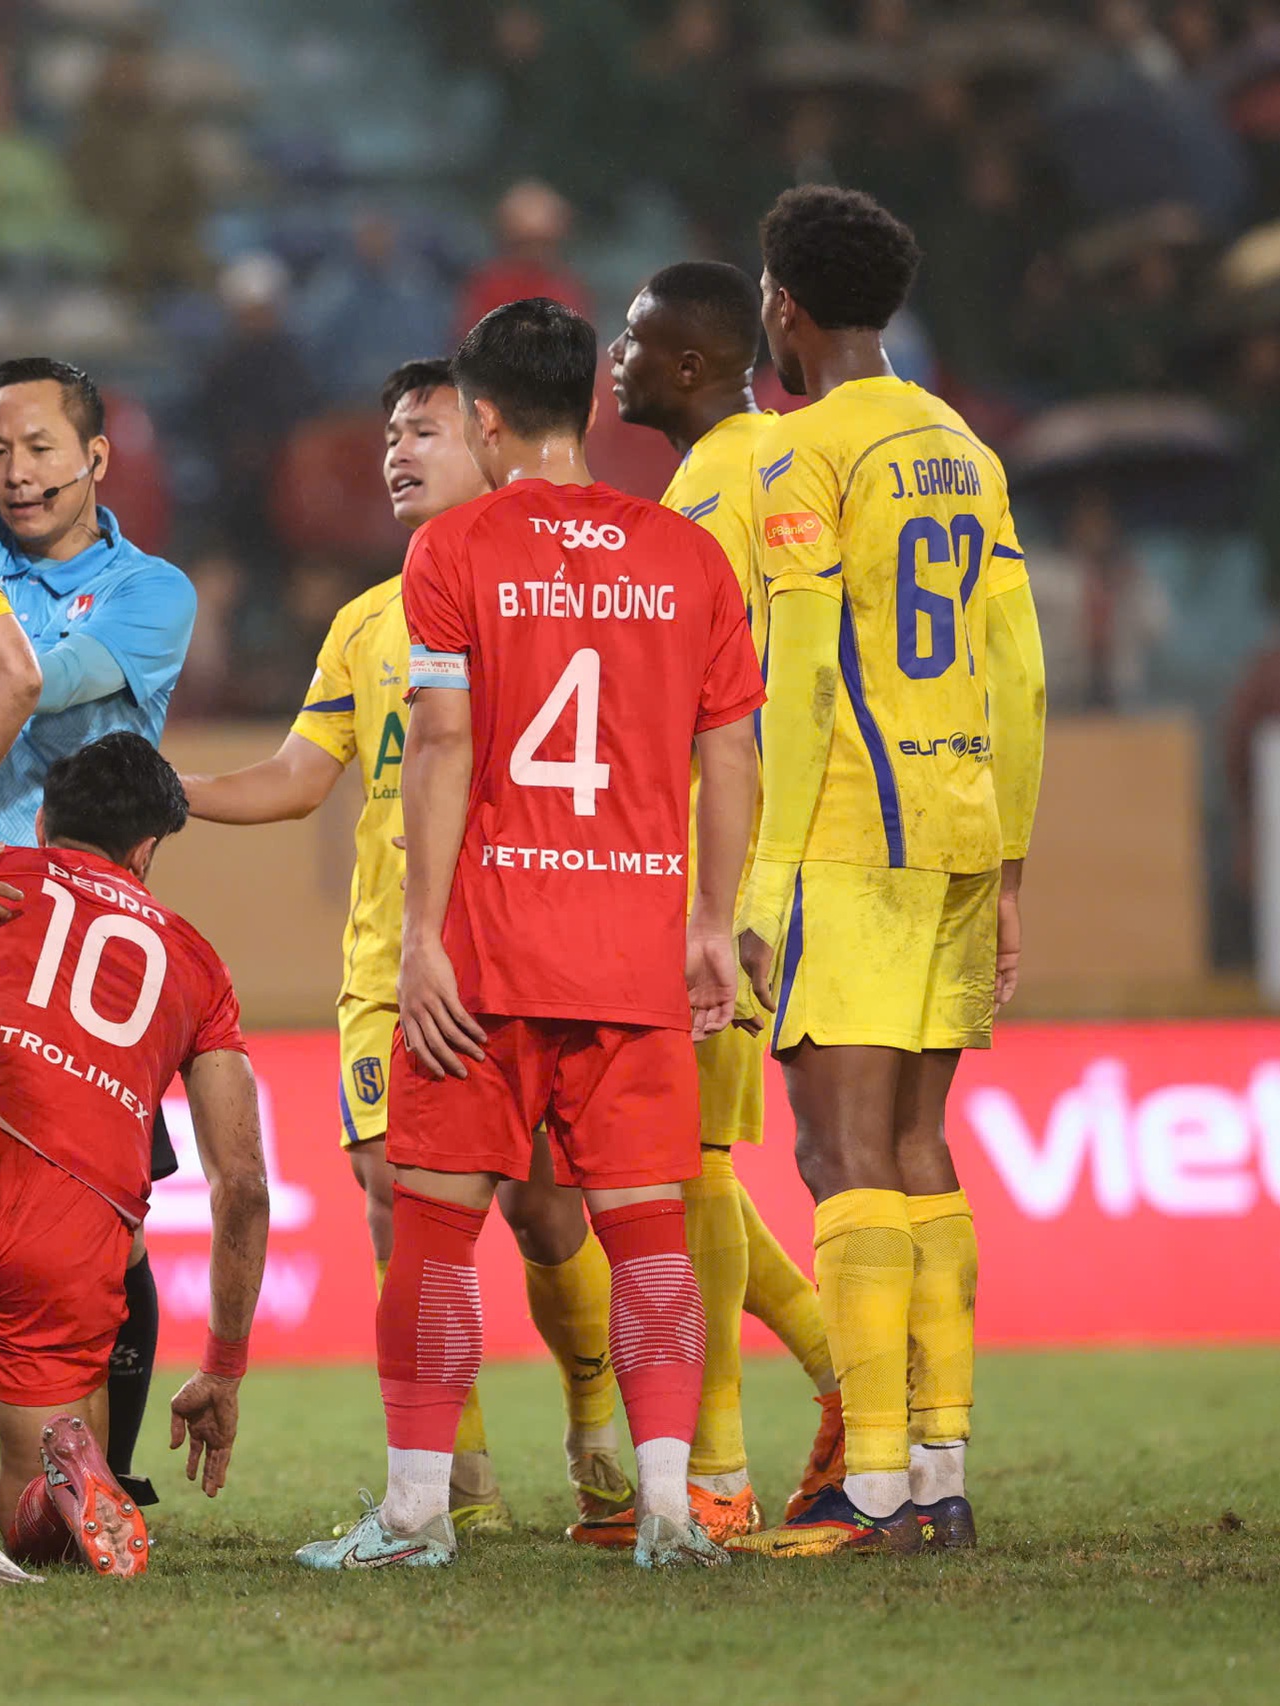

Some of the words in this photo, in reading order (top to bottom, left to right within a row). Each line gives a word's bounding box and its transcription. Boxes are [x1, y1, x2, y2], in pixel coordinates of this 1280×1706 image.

[888, 462, 913, 499] J.
[913, 454, 981, 496] GARCÍA
[528, 517, 626, 551] TV360
[767, 524, 805, 540] LPBank
[592, 575, 676, 620] DŨNG
[510, 648, 610, 816] 4
[481, 845, 684, 875] PETROLIMEX
[26, 877, 167, 1048] 10
